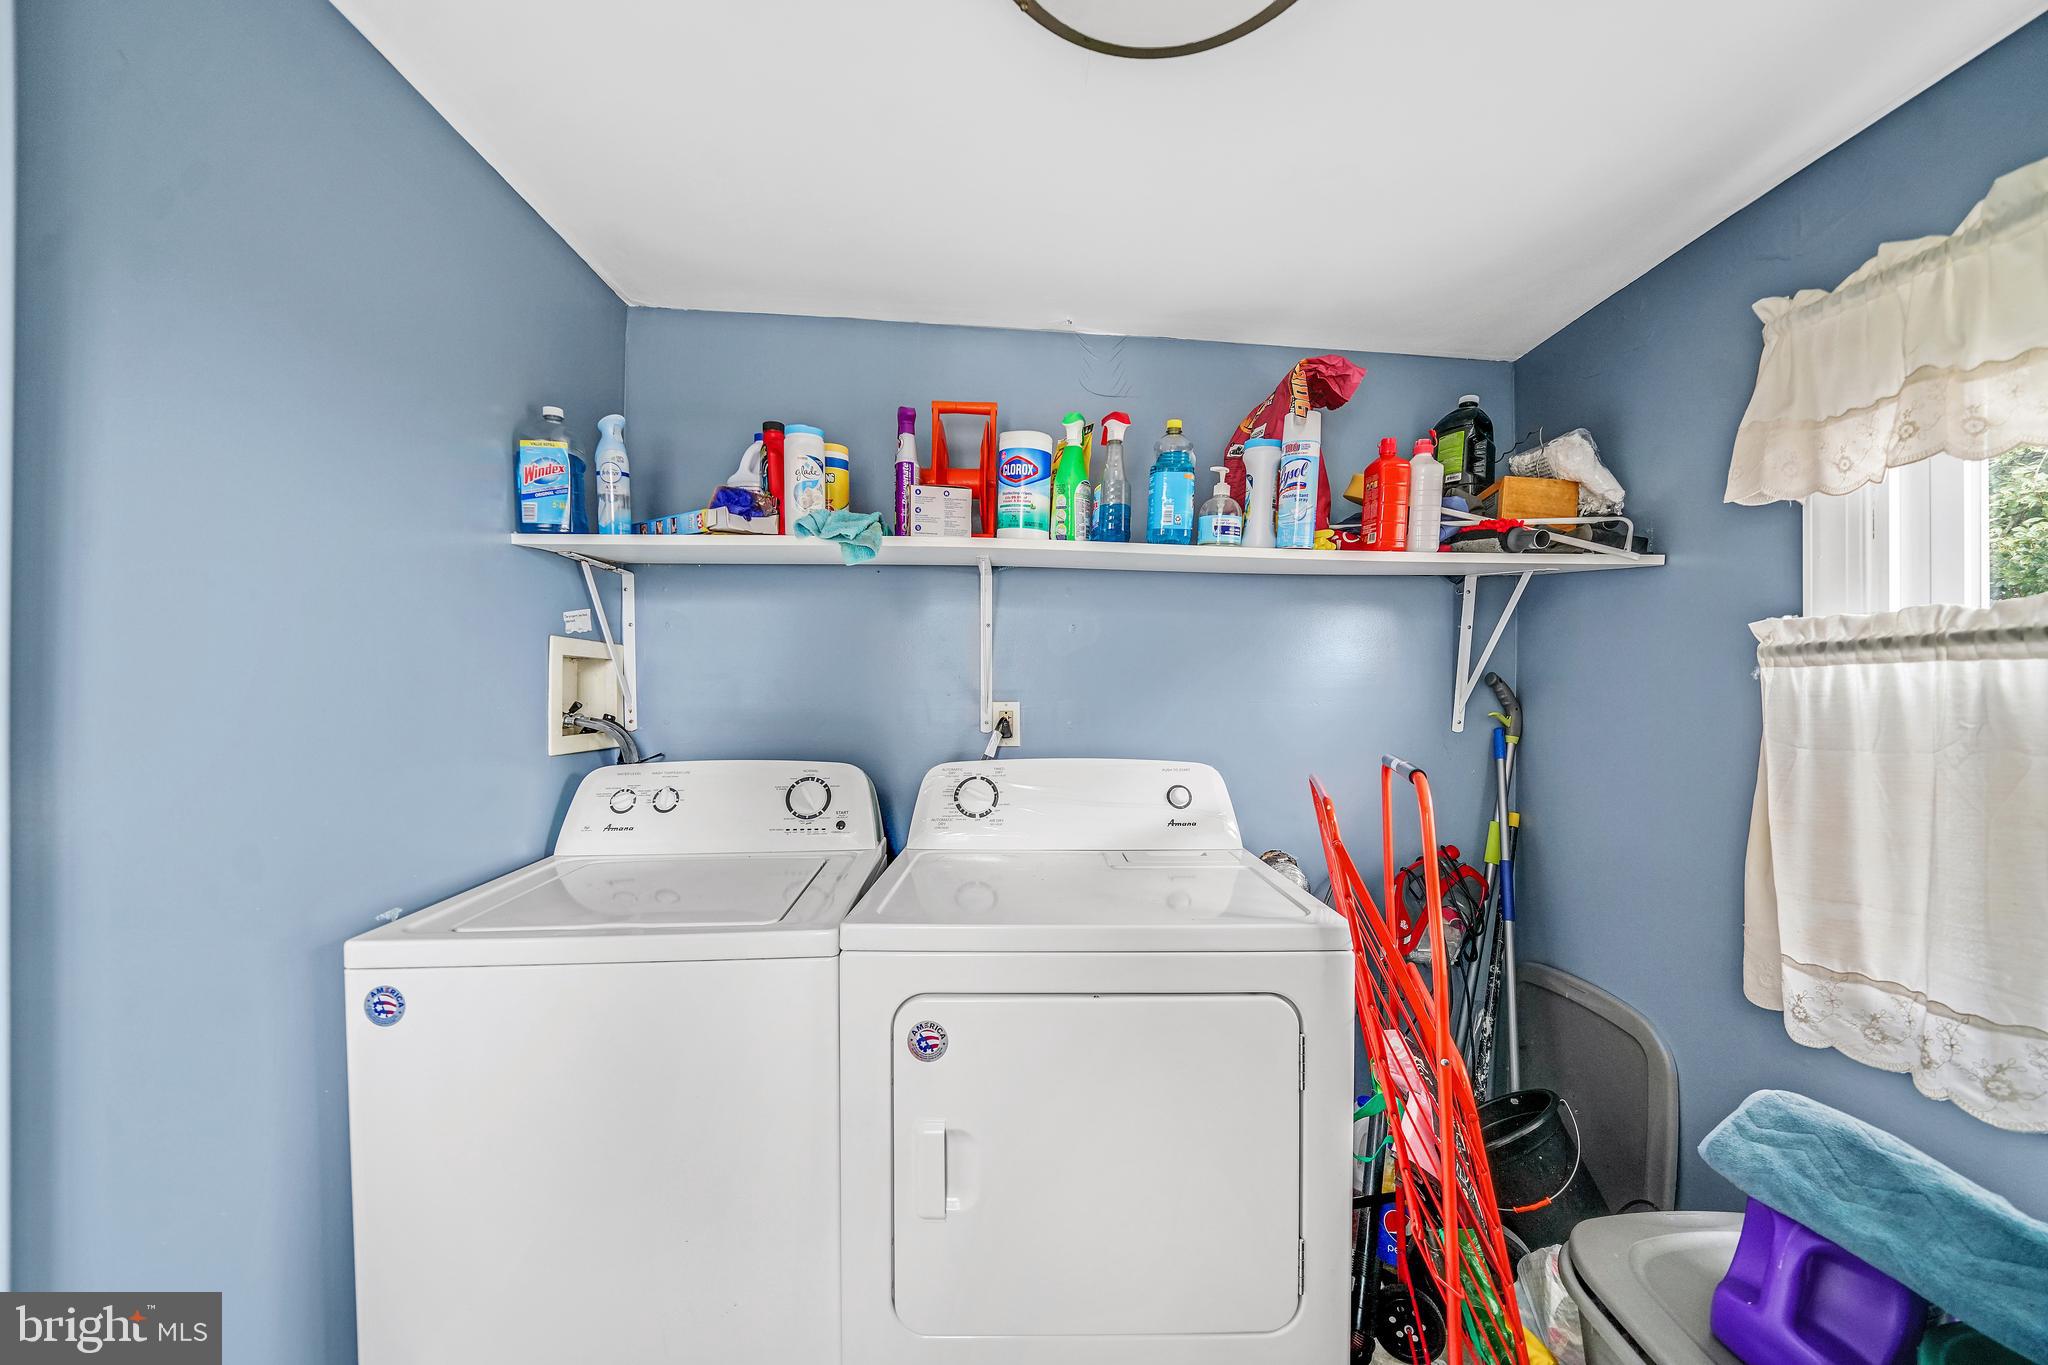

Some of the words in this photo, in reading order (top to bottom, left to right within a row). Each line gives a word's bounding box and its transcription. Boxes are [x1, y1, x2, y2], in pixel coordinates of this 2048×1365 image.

[524, 463, 565, 485] Windex
[795, 465, 820, 481] glade
[1002, 463, 1034, 476] CLOROX
[1280, 462, 1309, 491] Lysol
[602, 823, 635, 832] Amana
[1167, 818, 1197, 827] Amana
[370, 987, 404, 1008] AMERICA
[911, 1022, 946, 1040] AMERICA
